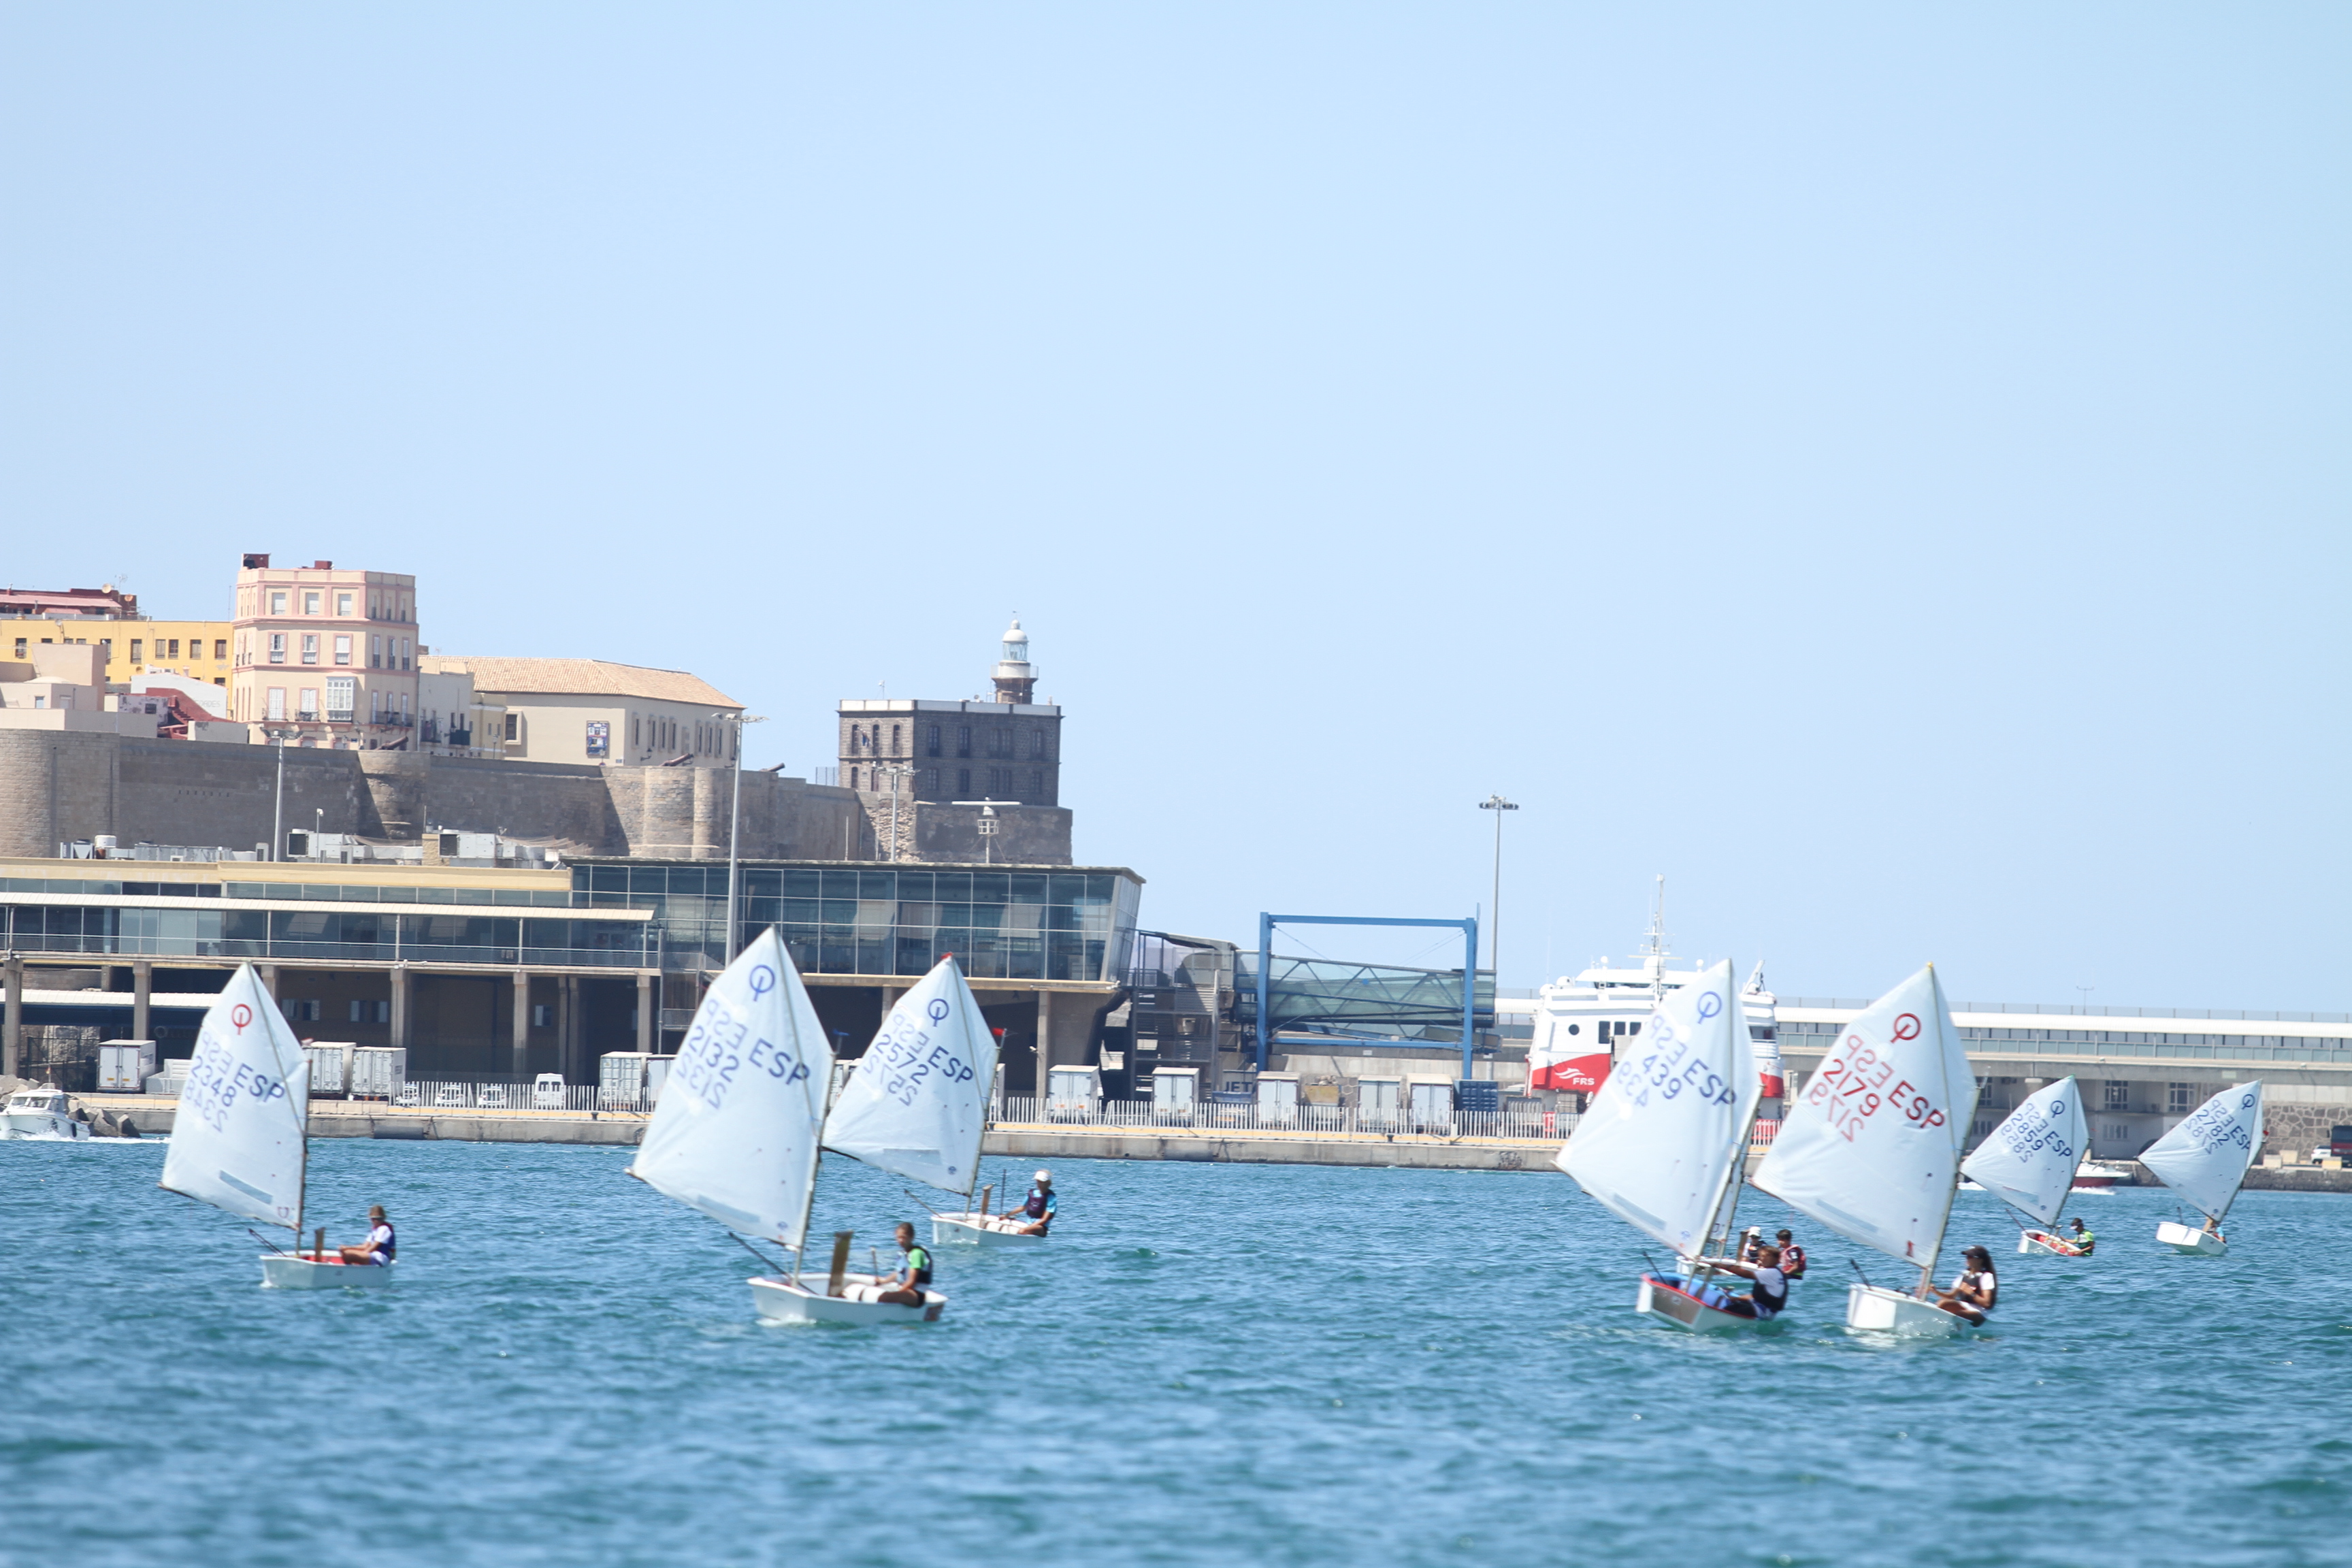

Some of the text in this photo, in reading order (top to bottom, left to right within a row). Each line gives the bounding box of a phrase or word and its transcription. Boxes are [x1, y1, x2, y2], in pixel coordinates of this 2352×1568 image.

[689, 1025, 739, 1082] 2132
[749, 1039, 810, 1085] ESP
[875, 1034, 929, 1085] 2572
[928, 1046, 973, 1083] ESP
[191, 1056, 236, 1107] 2348
[234, 1063, 285, 1102] ESP
[1573, 1077, 1595, 1085] FRS
[1643, 1054, 1681, 1100] 439
[1684, 1058, 1737, 1107] ESP
[1823, 1058, 1881, 1117] 2179
[1888, 1080, 1945, 1128] ESP
[2011, 1113, 2044, 1151] 2859
[2043, 1130, 2073, 1158] ESP
[2197, 1109, 2230, 1148] 2782
[2230, 1126, 2251, 1150] ESP
